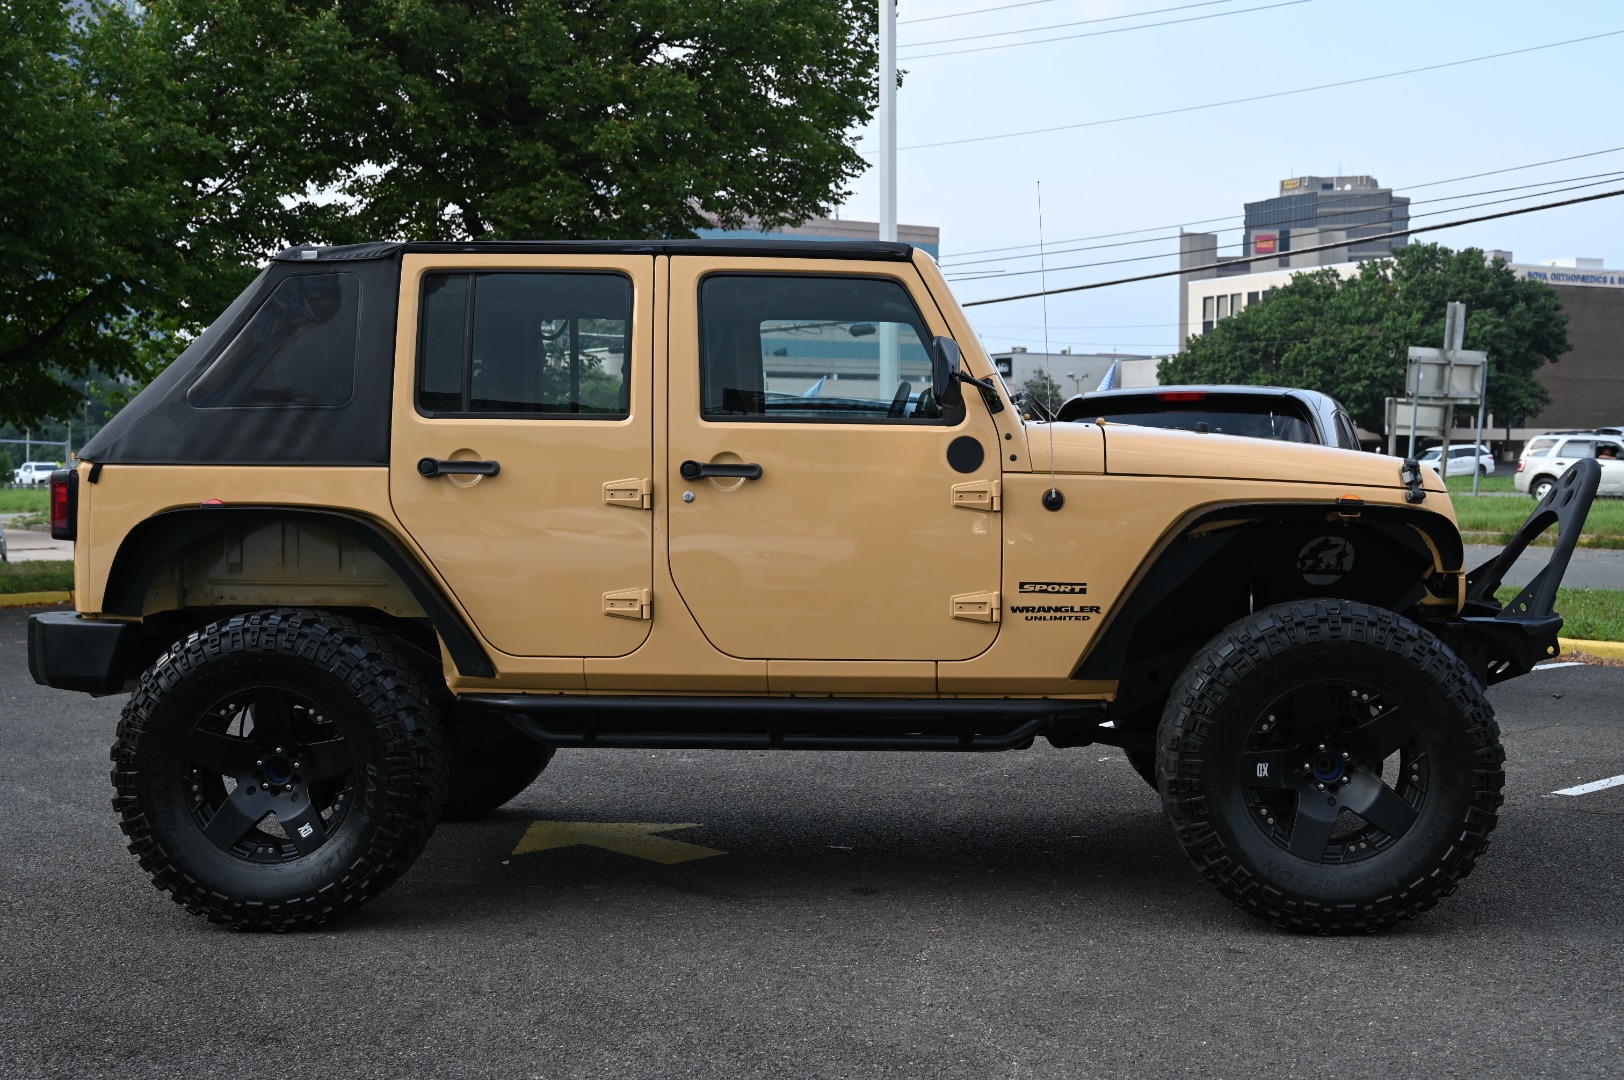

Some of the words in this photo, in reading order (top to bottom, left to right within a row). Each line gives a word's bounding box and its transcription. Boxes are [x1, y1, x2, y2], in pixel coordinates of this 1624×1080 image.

[1527, 271, 1548, 281] NOVA
[1551, 272, 1608, 285] ORTHOPAEDICS
[1019, 583, 1087, 593] SPORT
